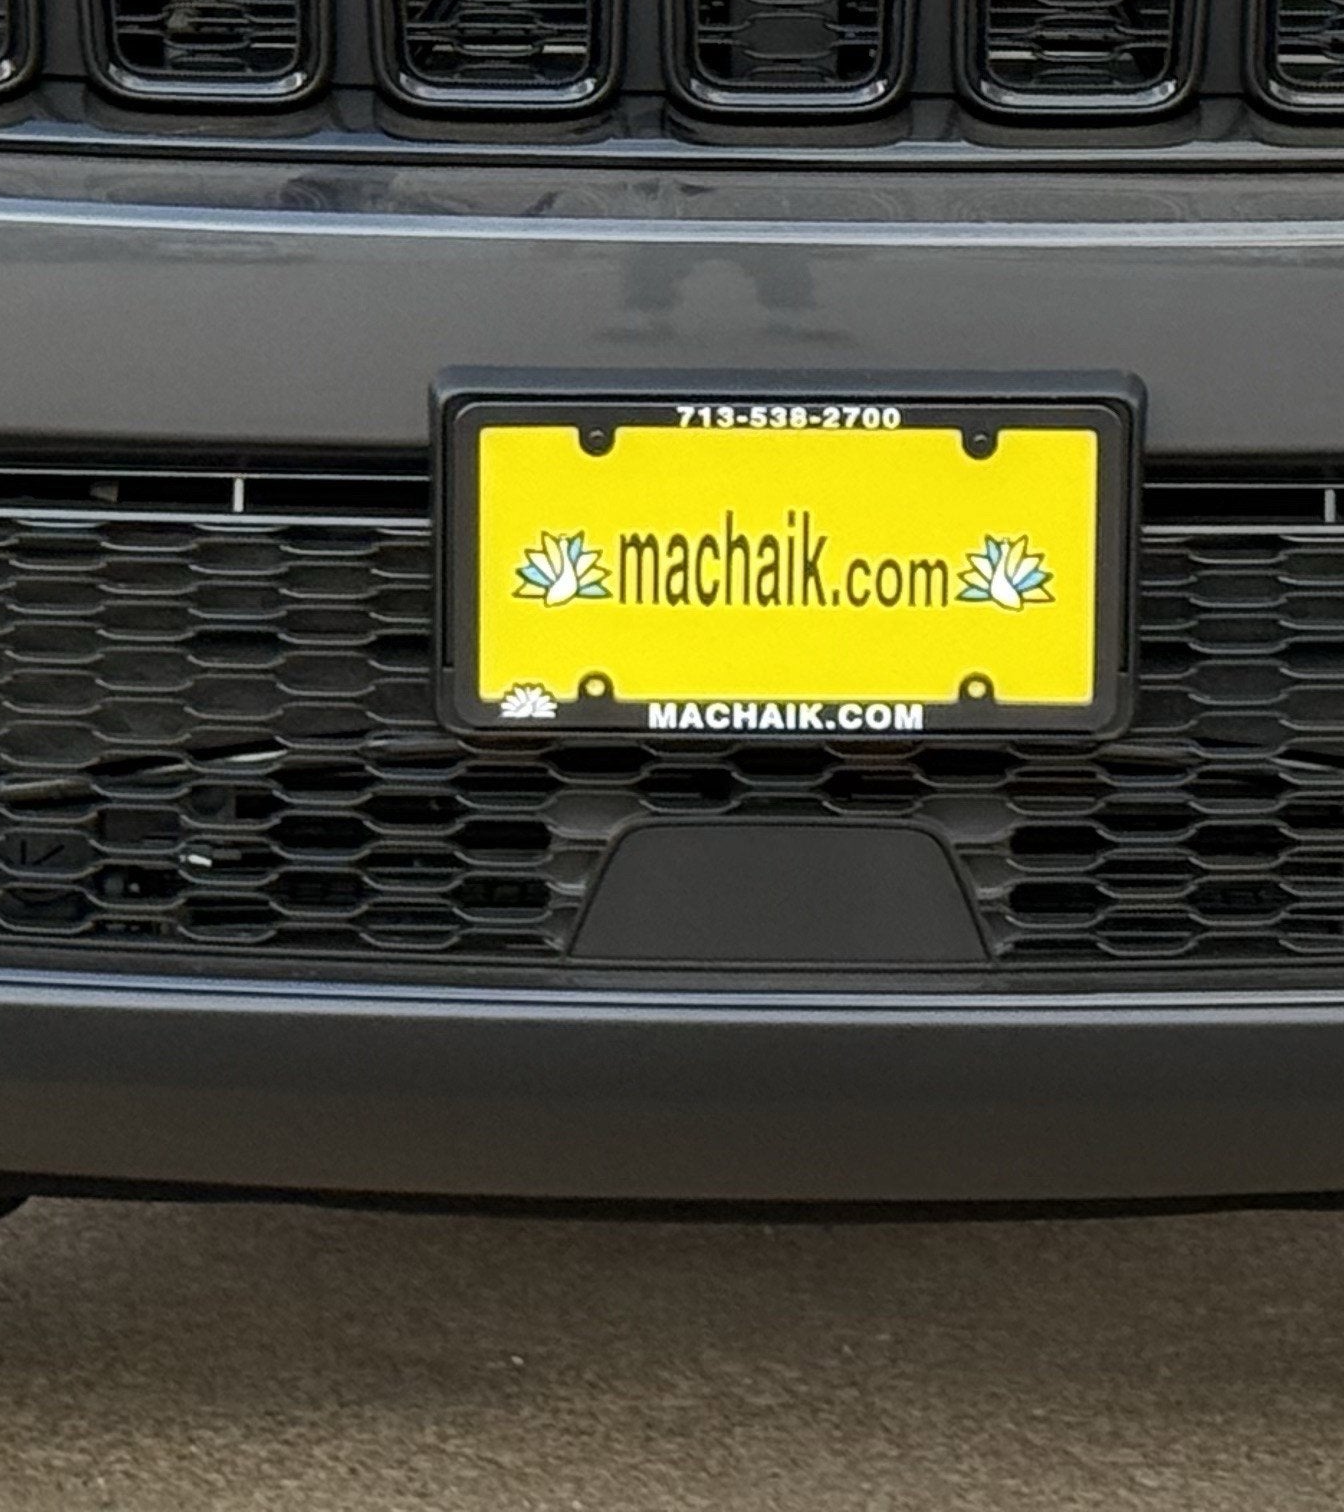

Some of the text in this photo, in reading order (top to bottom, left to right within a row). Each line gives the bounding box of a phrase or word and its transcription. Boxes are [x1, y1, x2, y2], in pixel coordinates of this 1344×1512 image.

[676, 406, 901, 429] 713-538-2700
[619, 510, 949, 607] machaik.com
[648, 702, 924, 730] MACHAIK.COM
